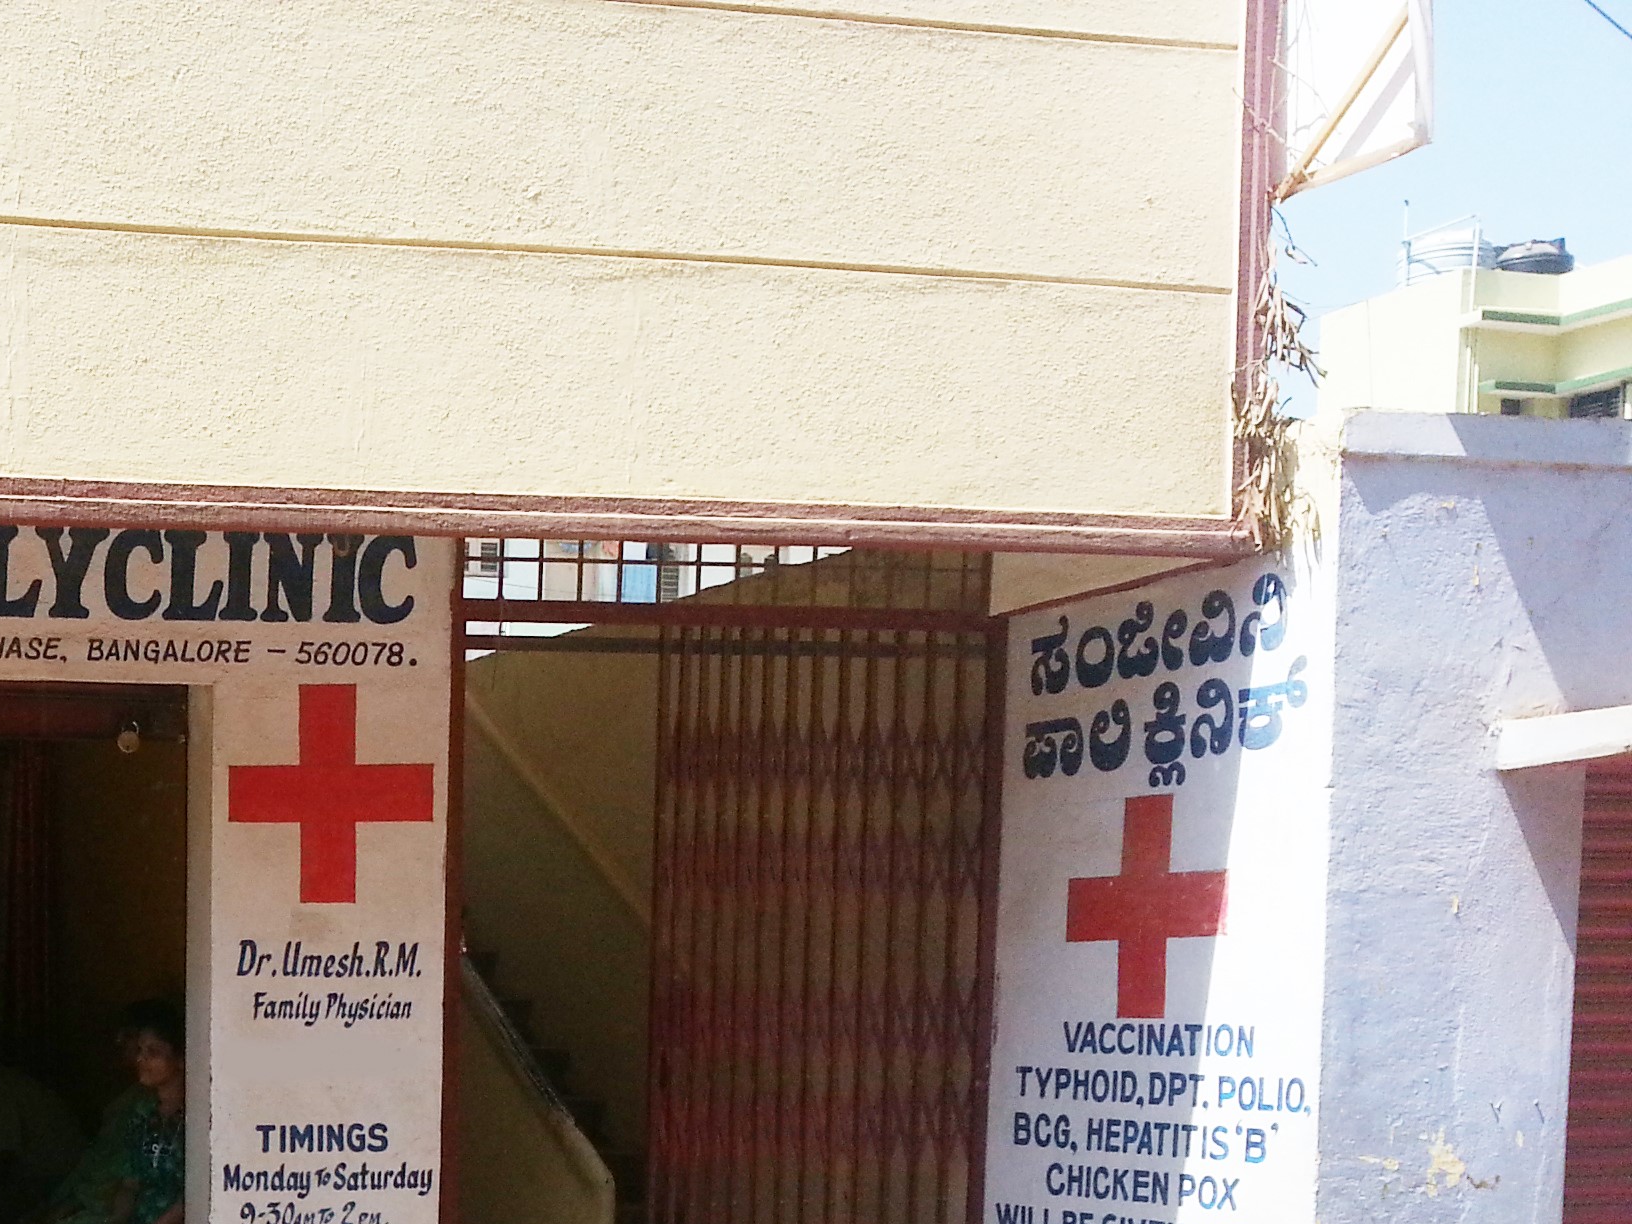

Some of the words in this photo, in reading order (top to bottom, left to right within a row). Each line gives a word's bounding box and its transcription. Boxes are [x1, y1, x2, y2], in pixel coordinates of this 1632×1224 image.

[86, 638, 252, 664] BANGALORE
[253, 991, 321, 1027] Family
[324, 991, 412, 1028] Physician
[1064, 1020, 1255, 1058] VACCINATION
[255, 1122, 389, 1153] TIMINGS
[223, 1162, 312, 1199] Monday
[333, 1161, 434, 1196] Saturday
[1046, 1162, 1171, 1206] CHICKEN
[1178, 1173, 1240, 1212] POX
